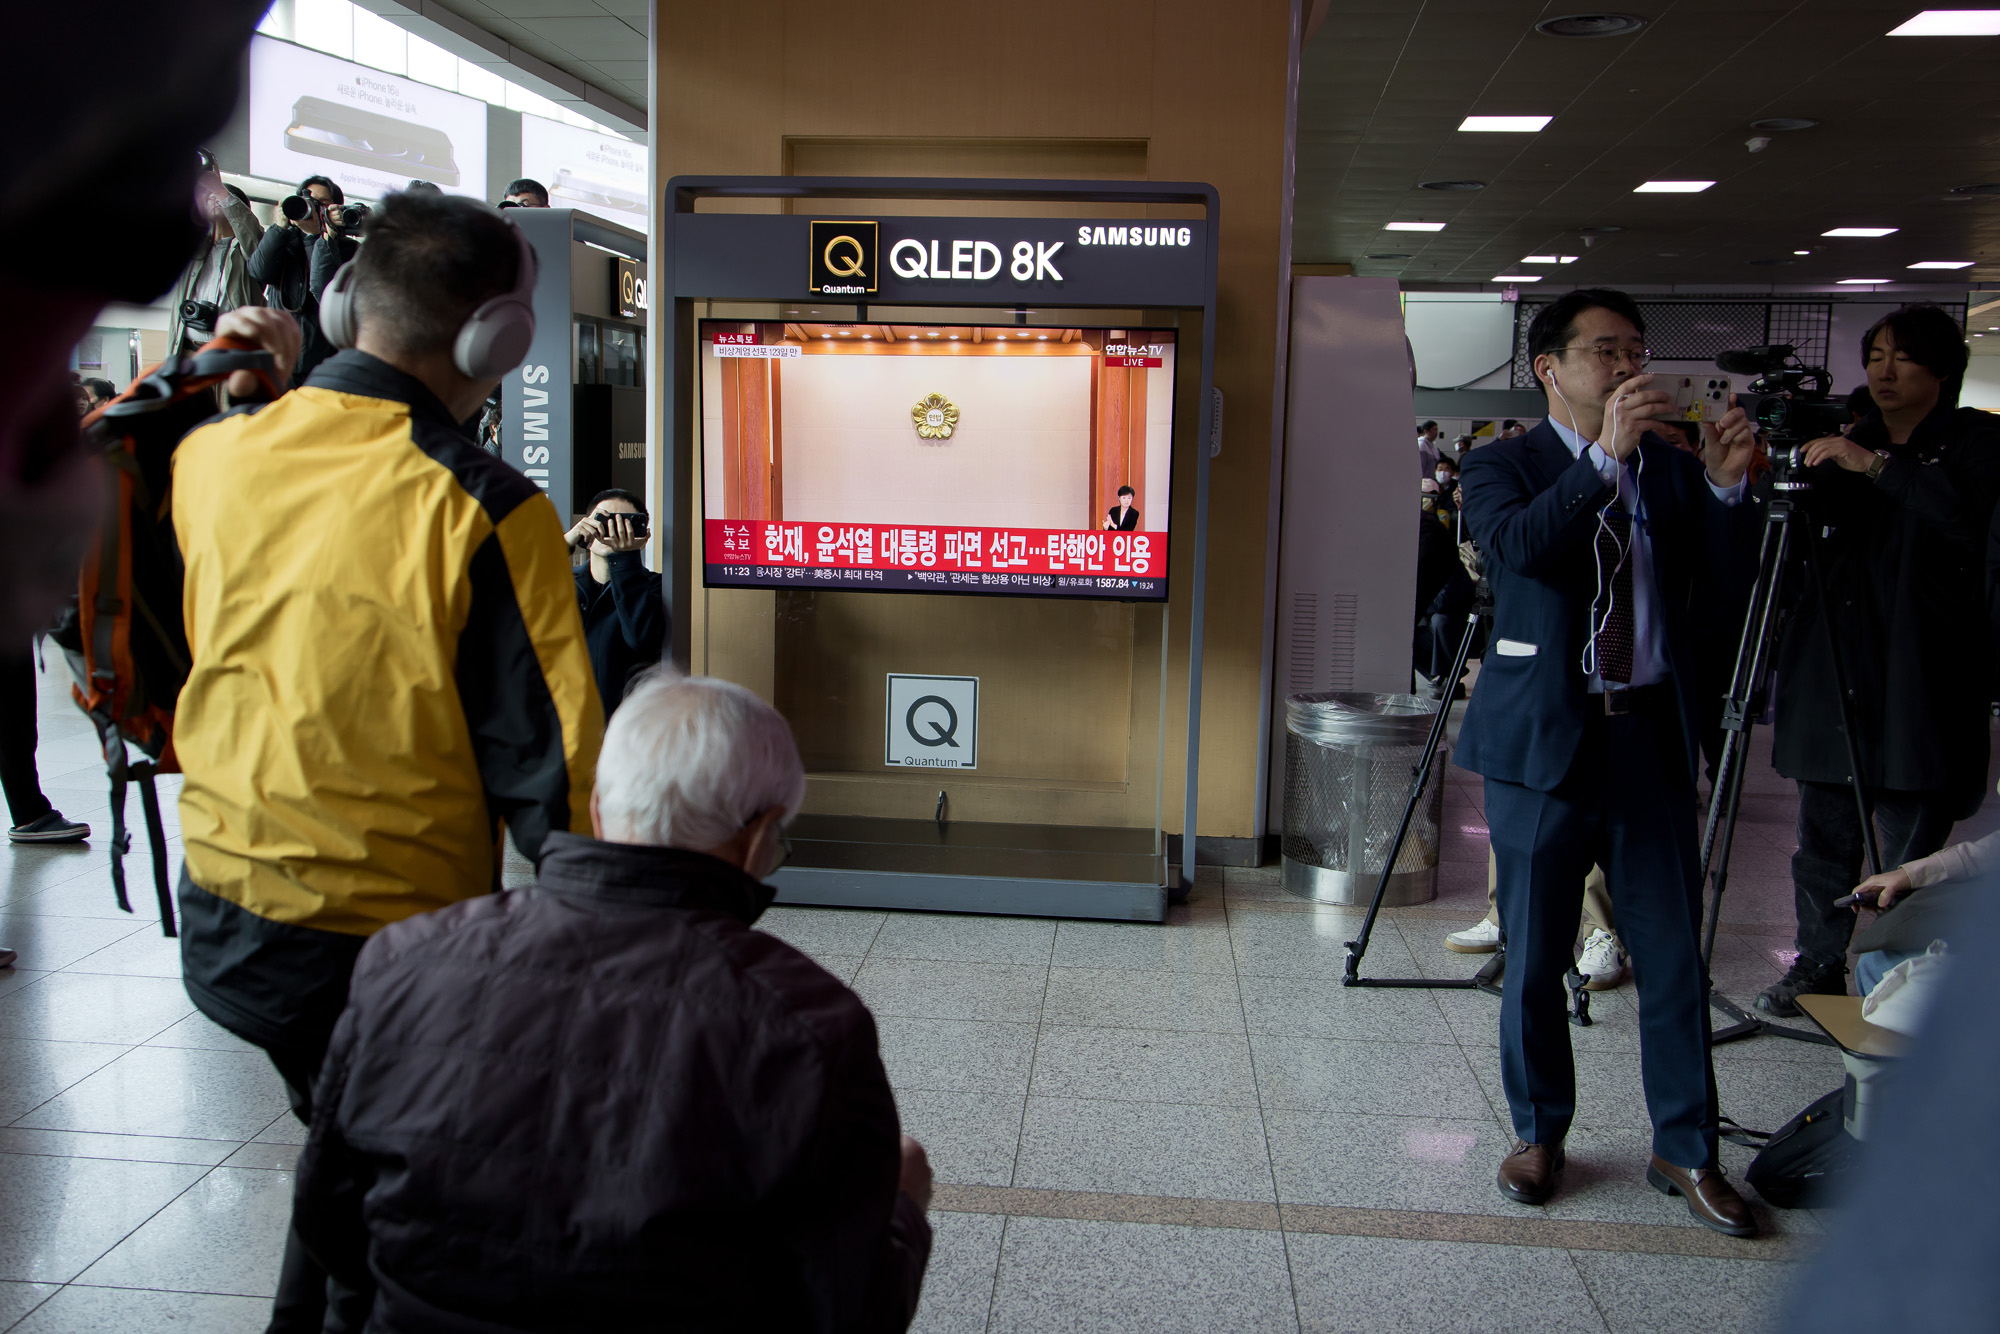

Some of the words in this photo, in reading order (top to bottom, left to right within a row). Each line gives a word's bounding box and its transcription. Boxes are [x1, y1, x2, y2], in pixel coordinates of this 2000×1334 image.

[361, 77, 387, 93] iPhone
[1078, 226, 1191, 246] SAMSUNG
[824, 235, 867, 278] Q
[889, 238, 1002, 280] QLED
[1010, 240, 1065, 281] 8K
[822, 284, 865, 294] Quantum
[719, 334, 753, 344] 뉴스특보
[719, 346, 751, 357] 비상계엄
[752, 348, 768, 357] 선포
[769, 347, 788, 358] 123일
[790, 348, 798, 358] 만
[1105, 344, 1163, 356] 연합뉴스TV
[1123, 358, 1144, 367] LIVE
[522, 364, 550, 499] SAMSU
[723, 525, 750, 537] 뉴스
[723, 538, 750, 551] 속보
[764, 524, 809, 564] 헌재,
[816, 526, 873, 564] 윤석열
[881, 528, 937, 567] 대통령
[943, 530, 982, 568] 파면
[1112, 535, 1152, 574] 인용
[723, 566, 750, 576] 11:23
[844, 569, 862, 580] 최대
[864, 570, 883, 581] 타격
[981, 574, 1010, 585] 협상용
[1011, 574, 1030, 586] 아닌
[1057, 576, 1093, 588] 원/유로화
[1095, 578, 1130, 589] 1587.84
[906, 695, 960, 748] Q
[904, 756, 958, 768] Quantum
